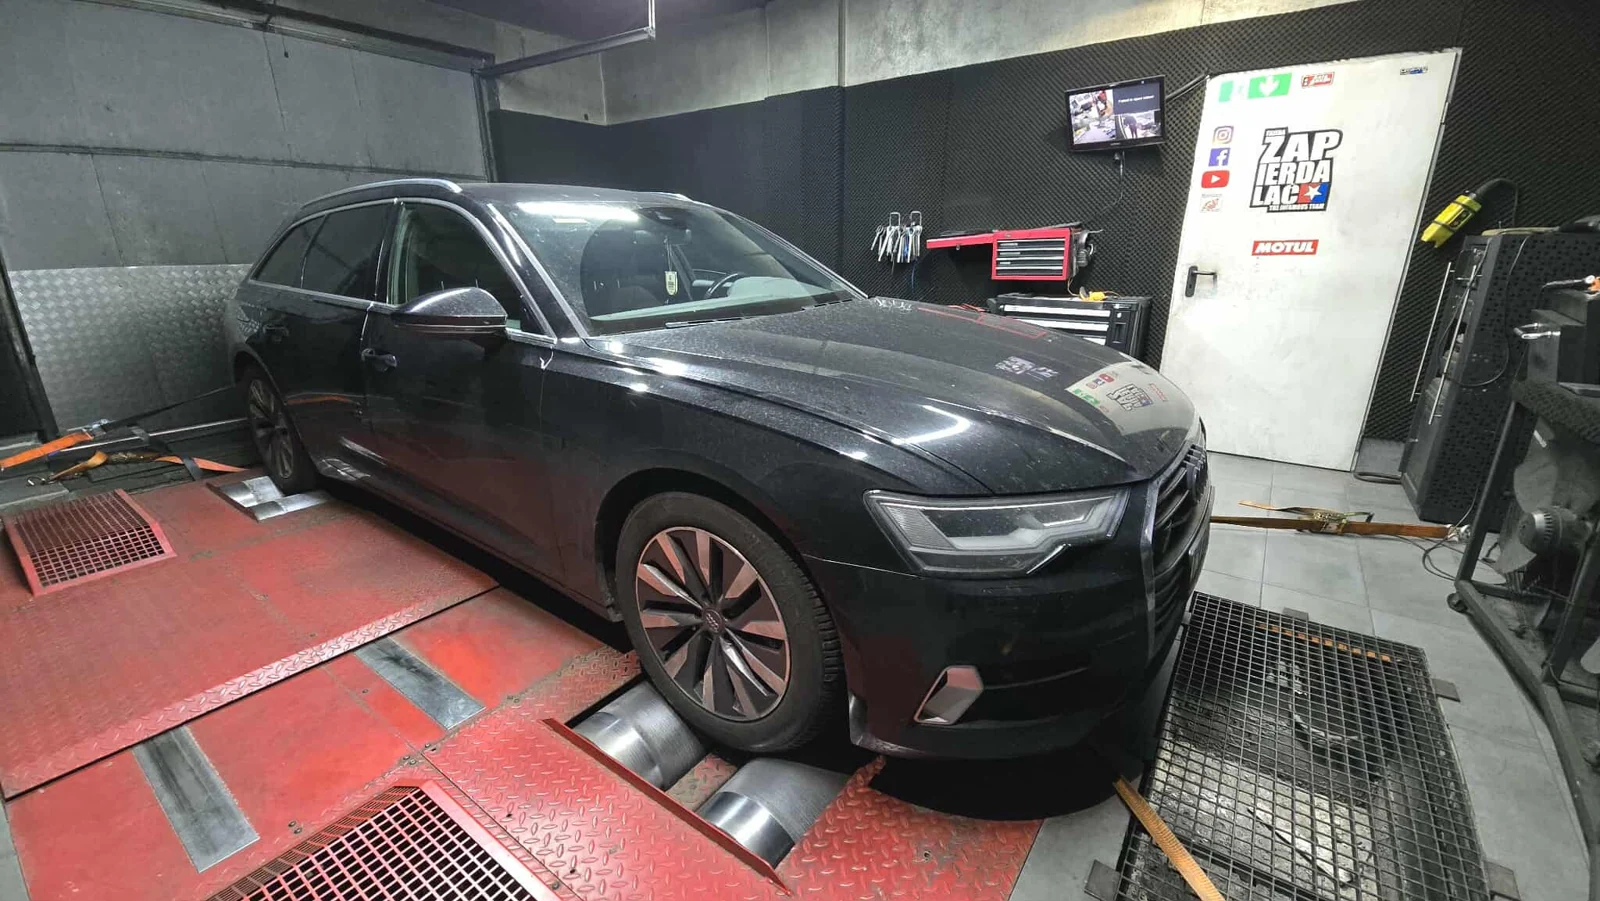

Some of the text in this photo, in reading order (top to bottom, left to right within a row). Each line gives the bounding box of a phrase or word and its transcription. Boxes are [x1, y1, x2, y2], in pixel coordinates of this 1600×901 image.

[1260, 131, 1341, 163] ZAP
[1256, 160, 1330, 186] IERDA
[1255, 241, 1314, 253] MOTUL
